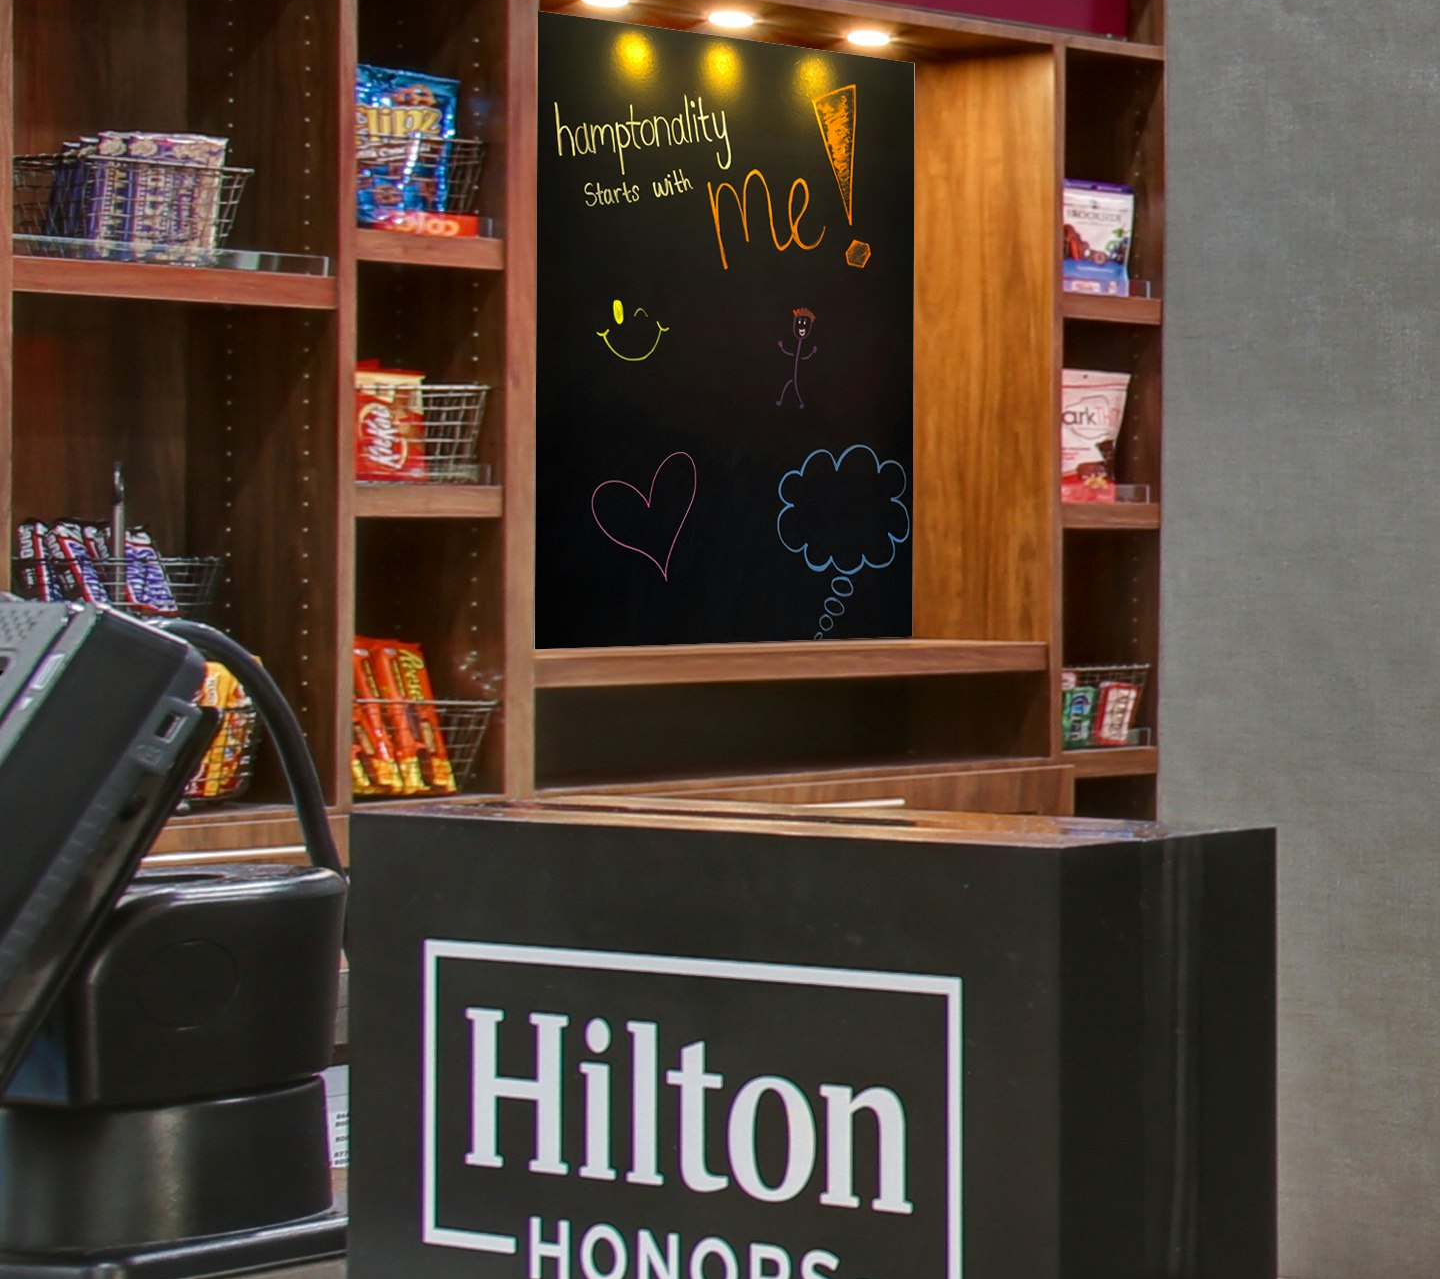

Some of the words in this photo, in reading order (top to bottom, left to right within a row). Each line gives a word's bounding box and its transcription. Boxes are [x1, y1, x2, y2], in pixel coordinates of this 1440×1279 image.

[357, 105, 443, 143] lipz
[554, 94, 732, 175] hamptonality
[653, 169, 694, 199] with
[465, 1006, 913, 1215] Hilton
